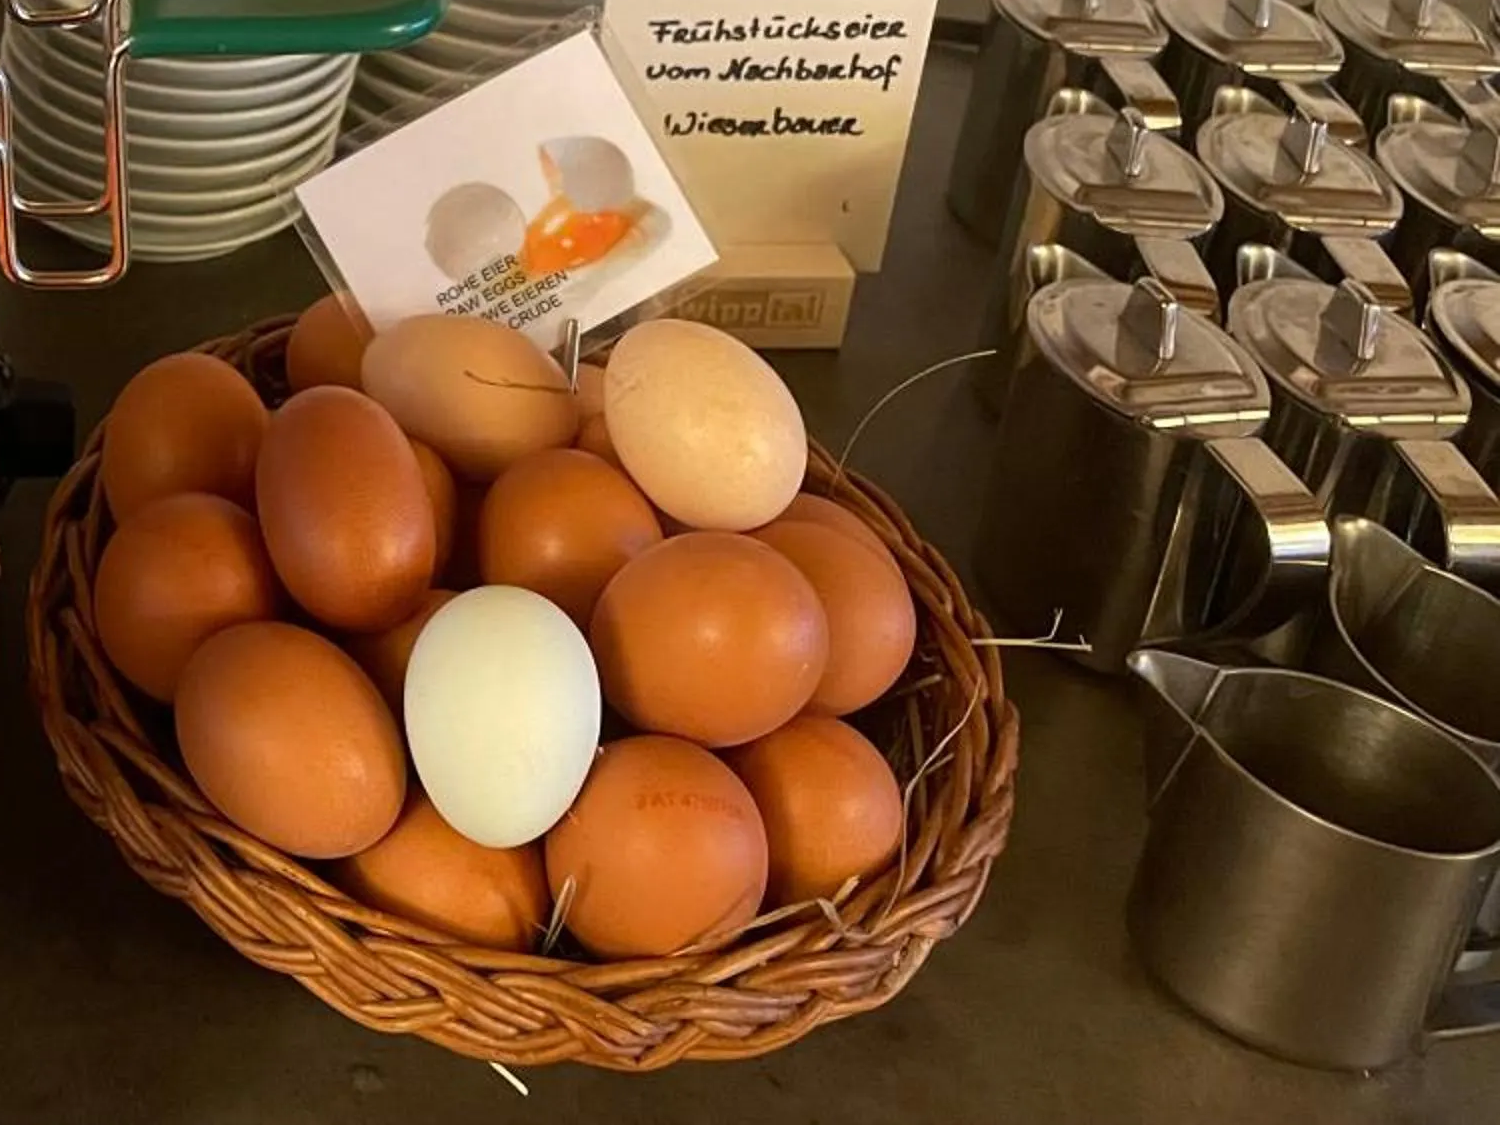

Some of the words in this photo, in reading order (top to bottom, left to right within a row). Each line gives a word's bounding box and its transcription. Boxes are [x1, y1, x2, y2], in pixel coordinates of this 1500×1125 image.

[646, 63, 710, 81] vom
[437, 274, 480, 307] ROHE
[481, 254, 518, 281] EIER
[482, 271, 526, 302] EGGS
[511, 269, 568, 307] EIEREN
[508, 293, 562, 330] CRUDE
